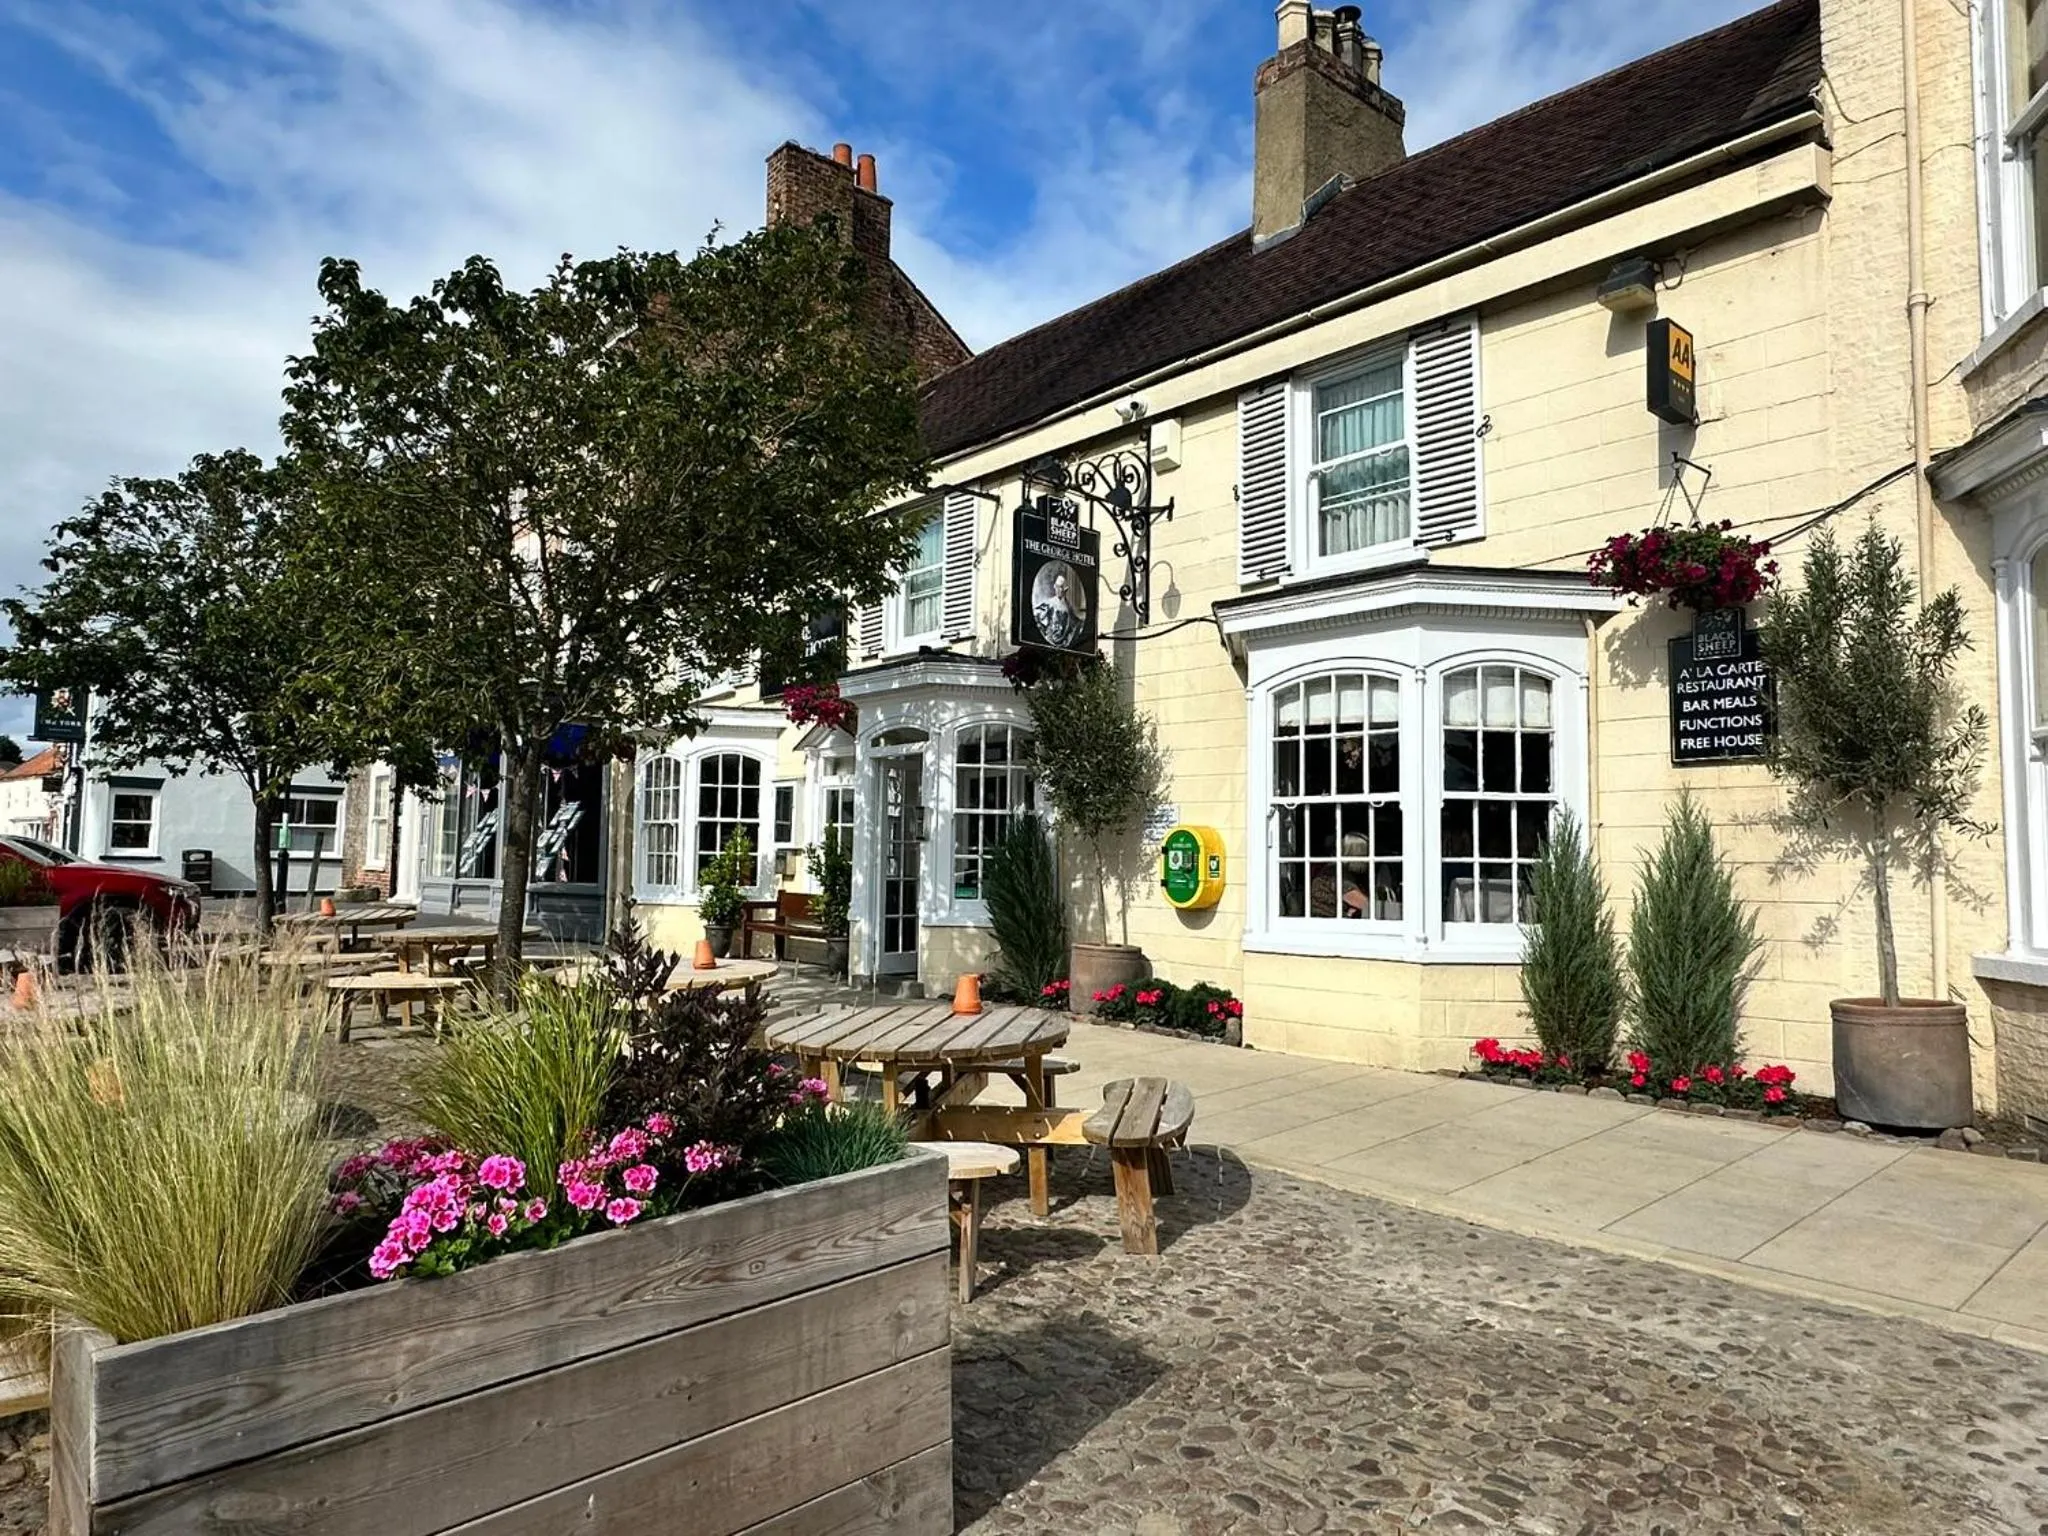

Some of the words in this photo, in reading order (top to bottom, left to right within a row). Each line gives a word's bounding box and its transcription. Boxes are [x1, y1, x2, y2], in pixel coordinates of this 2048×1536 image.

[1672, 337, 1690, 369] AA
[1050, 516, 1077, 532] BLACK
[1050, 526, 1077, 540] SHEEP
[1024, 538, 1041, 551] THE
[1697, 630, 1735, 643] BLACK
[1697, 640, 1736, 652] SHEEP
[1696, 666, 1714, 678] LA
[1717, 660, 1764, 676] CARTE
[1677, 674, 1767, 694] RESTAURANT
[1682, 700, 1710, 713] BAR
[1713, 695, 1757, 710] MEALS
[1679, 714, 1763, 731] FUNCTIONS
[1680, 736, 1711, 750] FREE
[1714, 733, 1763, 748] HOUSE
